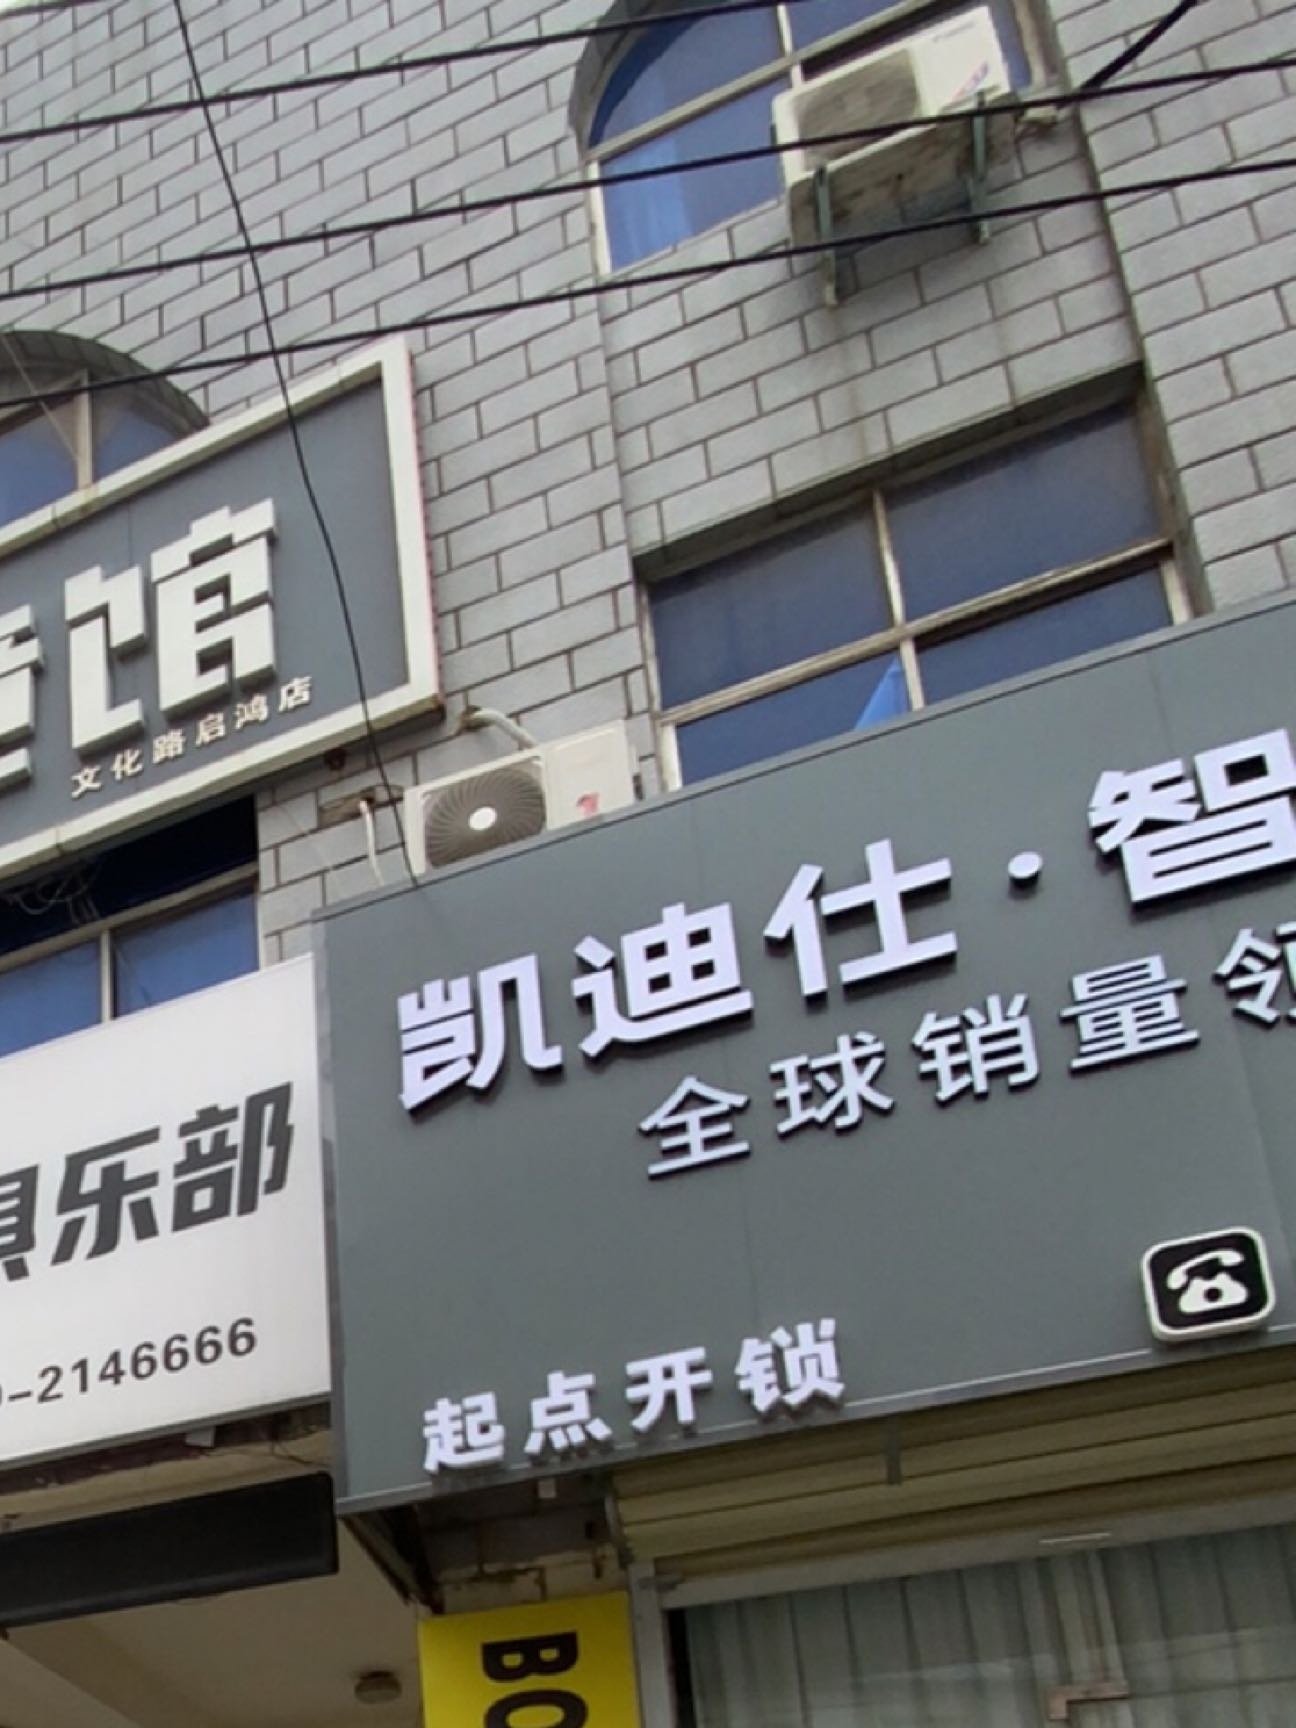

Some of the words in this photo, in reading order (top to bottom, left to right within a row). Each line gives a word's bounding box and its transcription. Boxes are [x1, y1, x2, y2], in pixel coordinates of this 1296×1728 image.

[71, 676, 312, 799] 文化路启鸿店
[422, 1316, 846, 1474] 起点开锁
